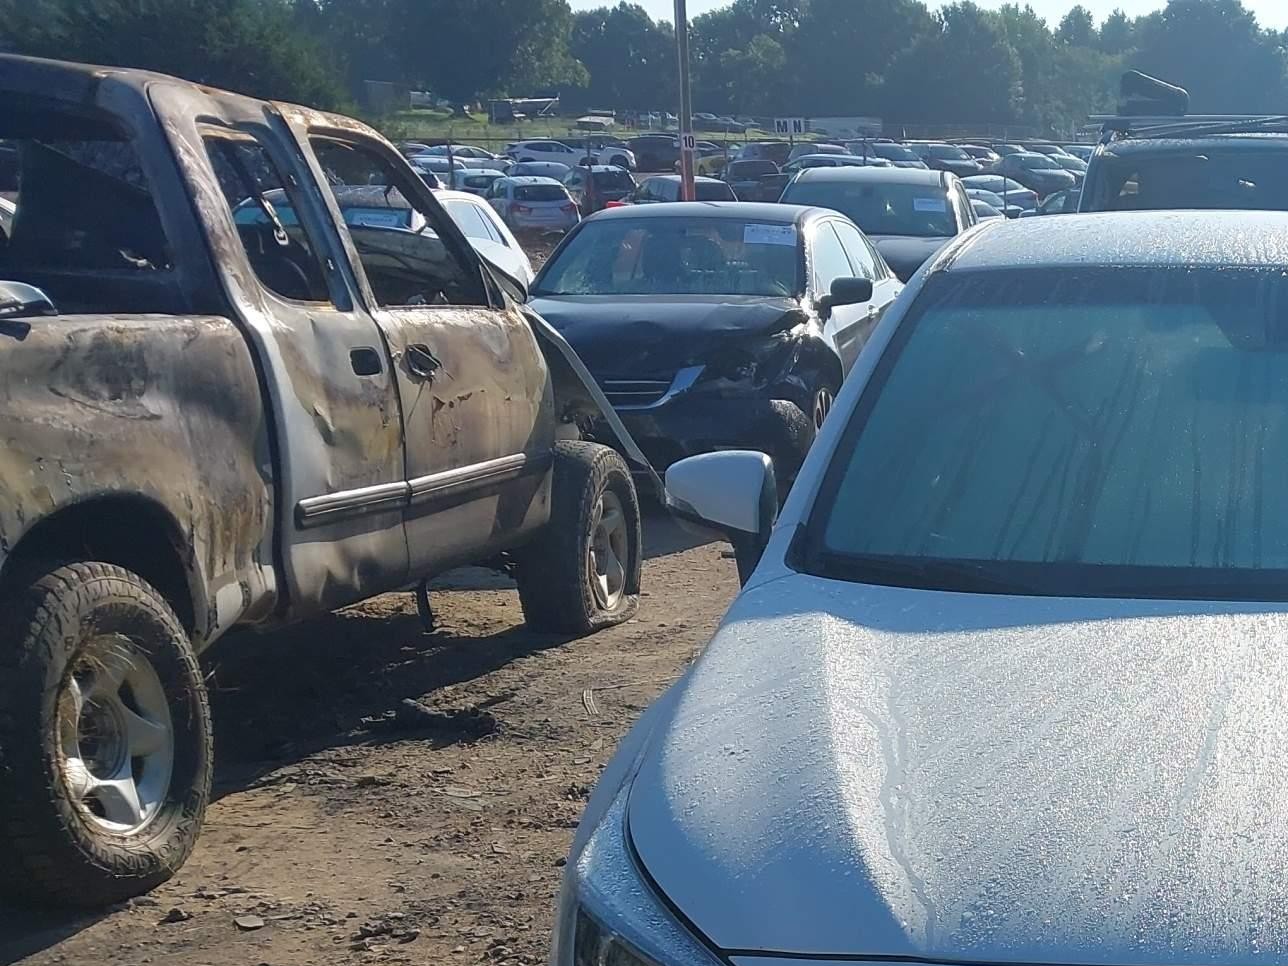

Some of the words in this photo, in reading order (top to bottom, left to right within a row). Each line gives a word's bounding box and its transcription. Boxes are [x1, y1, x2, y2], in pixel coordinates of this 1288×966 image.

[776, 119, 788, 133] M
[793, 119, 802, 133] N
[683, 135, 695, 149] 10
